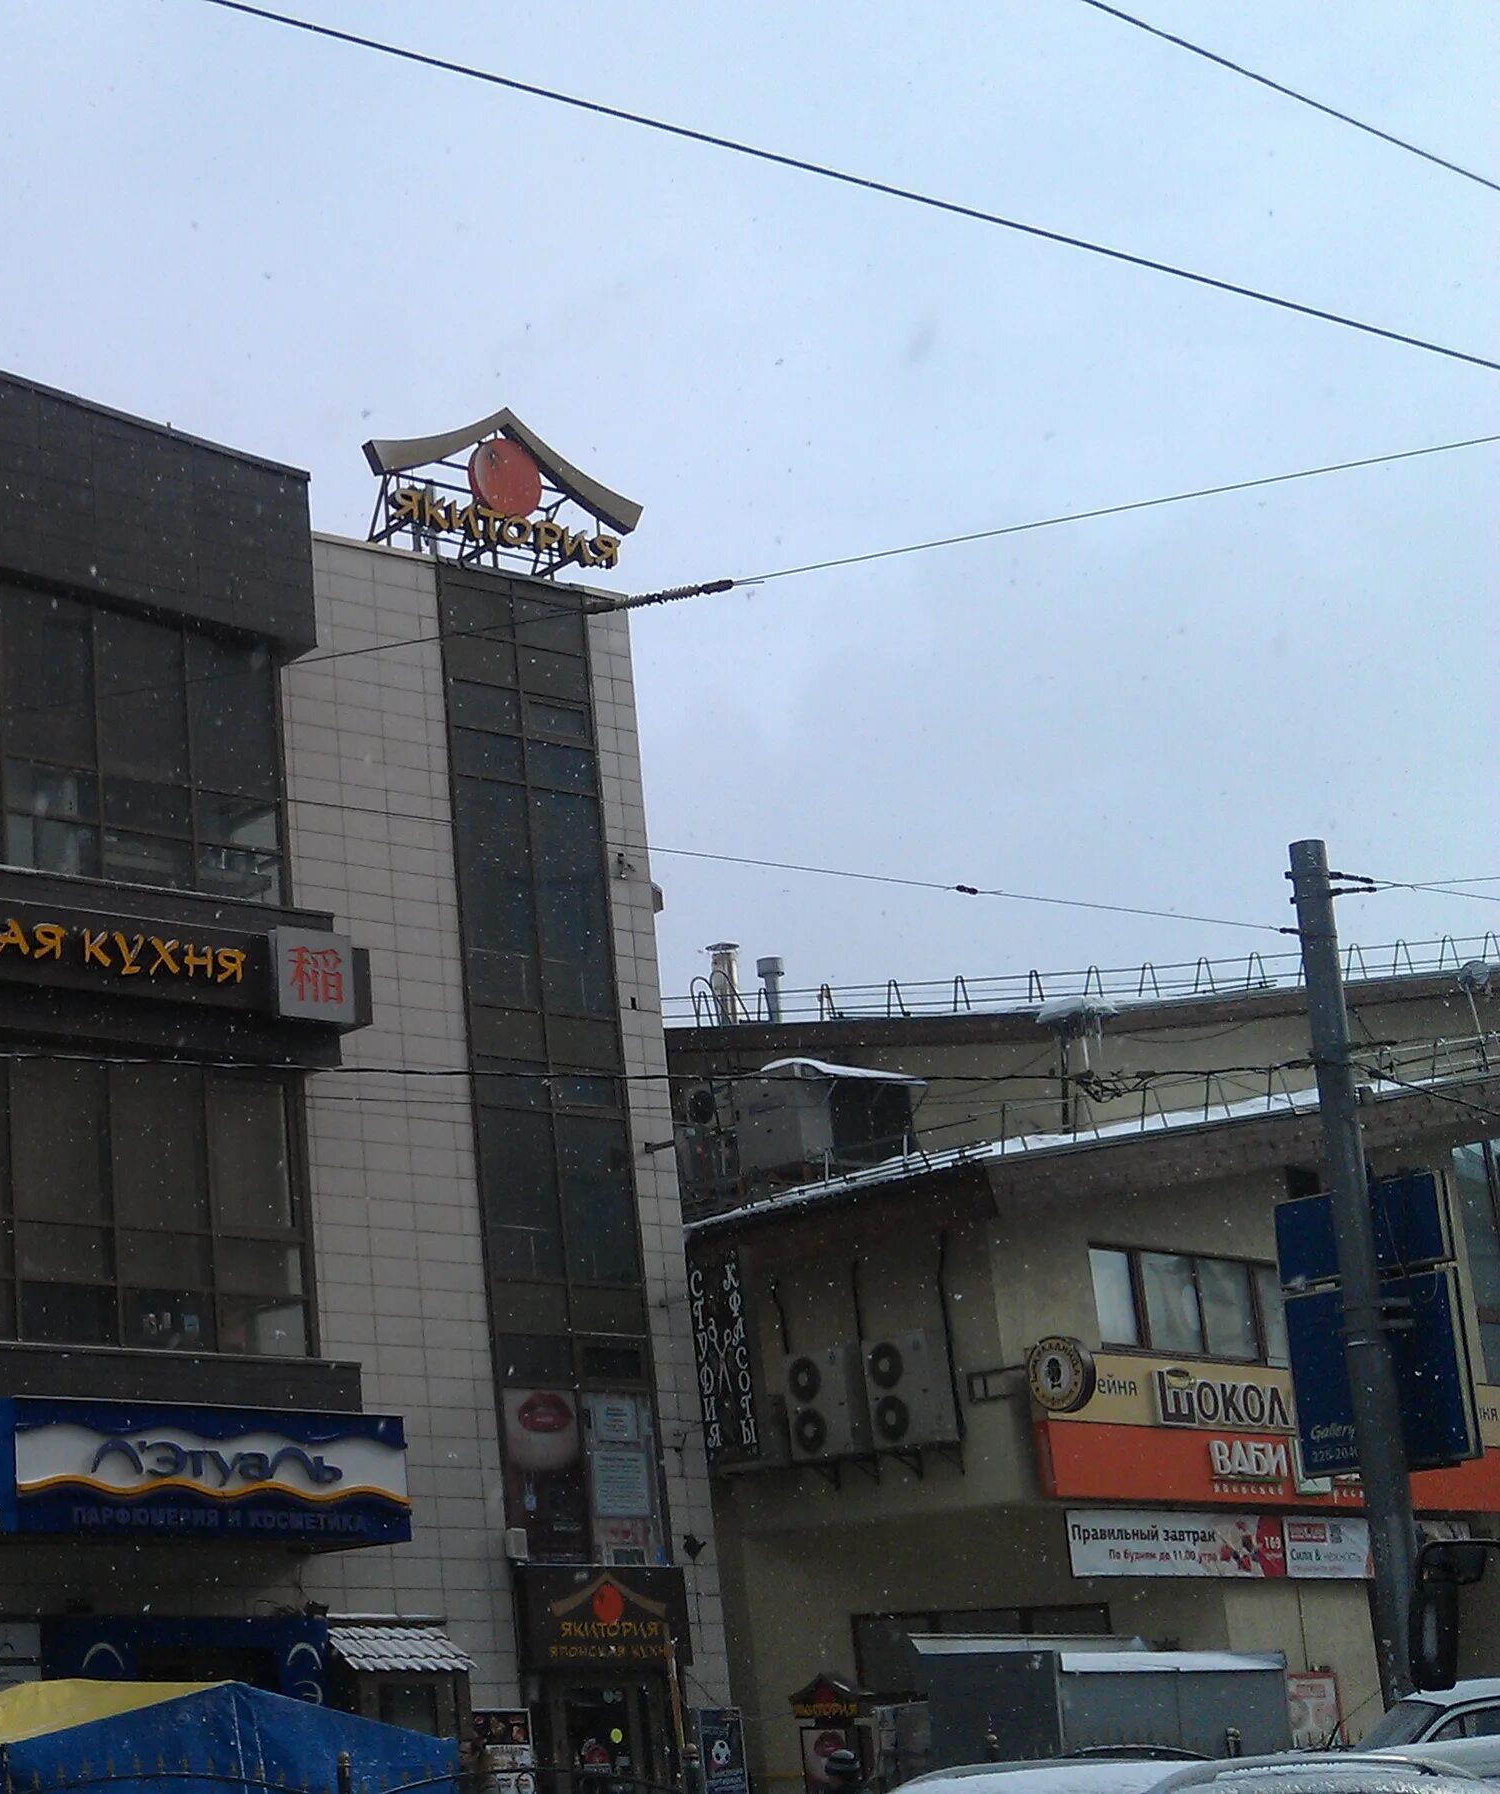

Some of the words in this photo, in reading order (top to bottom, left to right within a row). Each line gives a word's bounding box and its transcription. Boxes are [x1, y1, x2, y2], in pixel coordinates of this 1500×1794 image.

[390, 488, 621, 568] ЯКИТОРИЯ
[83, 928, 247, 984] КУХНЯ
[690, 1269, 722, 1447] СТУДИЯ
[1097, 1373, 1138, 1396] ейня
[1156, 1369, 1293, 1426] ШОКОЛ
[1310, 1422, 1356, 1443] Gallery
[1210, 1440, 1289, 1477] ВАБИ
[72, 1505, 219, 1527] ПАРФЮМЕРИЯ
[227, 1509, 242, 1528] И
[250, 1510, 368, 1532] КОСМЕТИКА
[1071, 1523, 1159, 1543] Правильный
[1163, 1529, 1217, 1545] завтрак
[1109, 1548, 1121, 1560] По
[1290, 1548, 1313, 1562] Сила
[560, 1621, 659, 1639] ЯКИТОРИЯ
[549, 1645, 627, 1658] ЯПОНСКАЯ
[631, 1646, 667, 1659] КУХН
